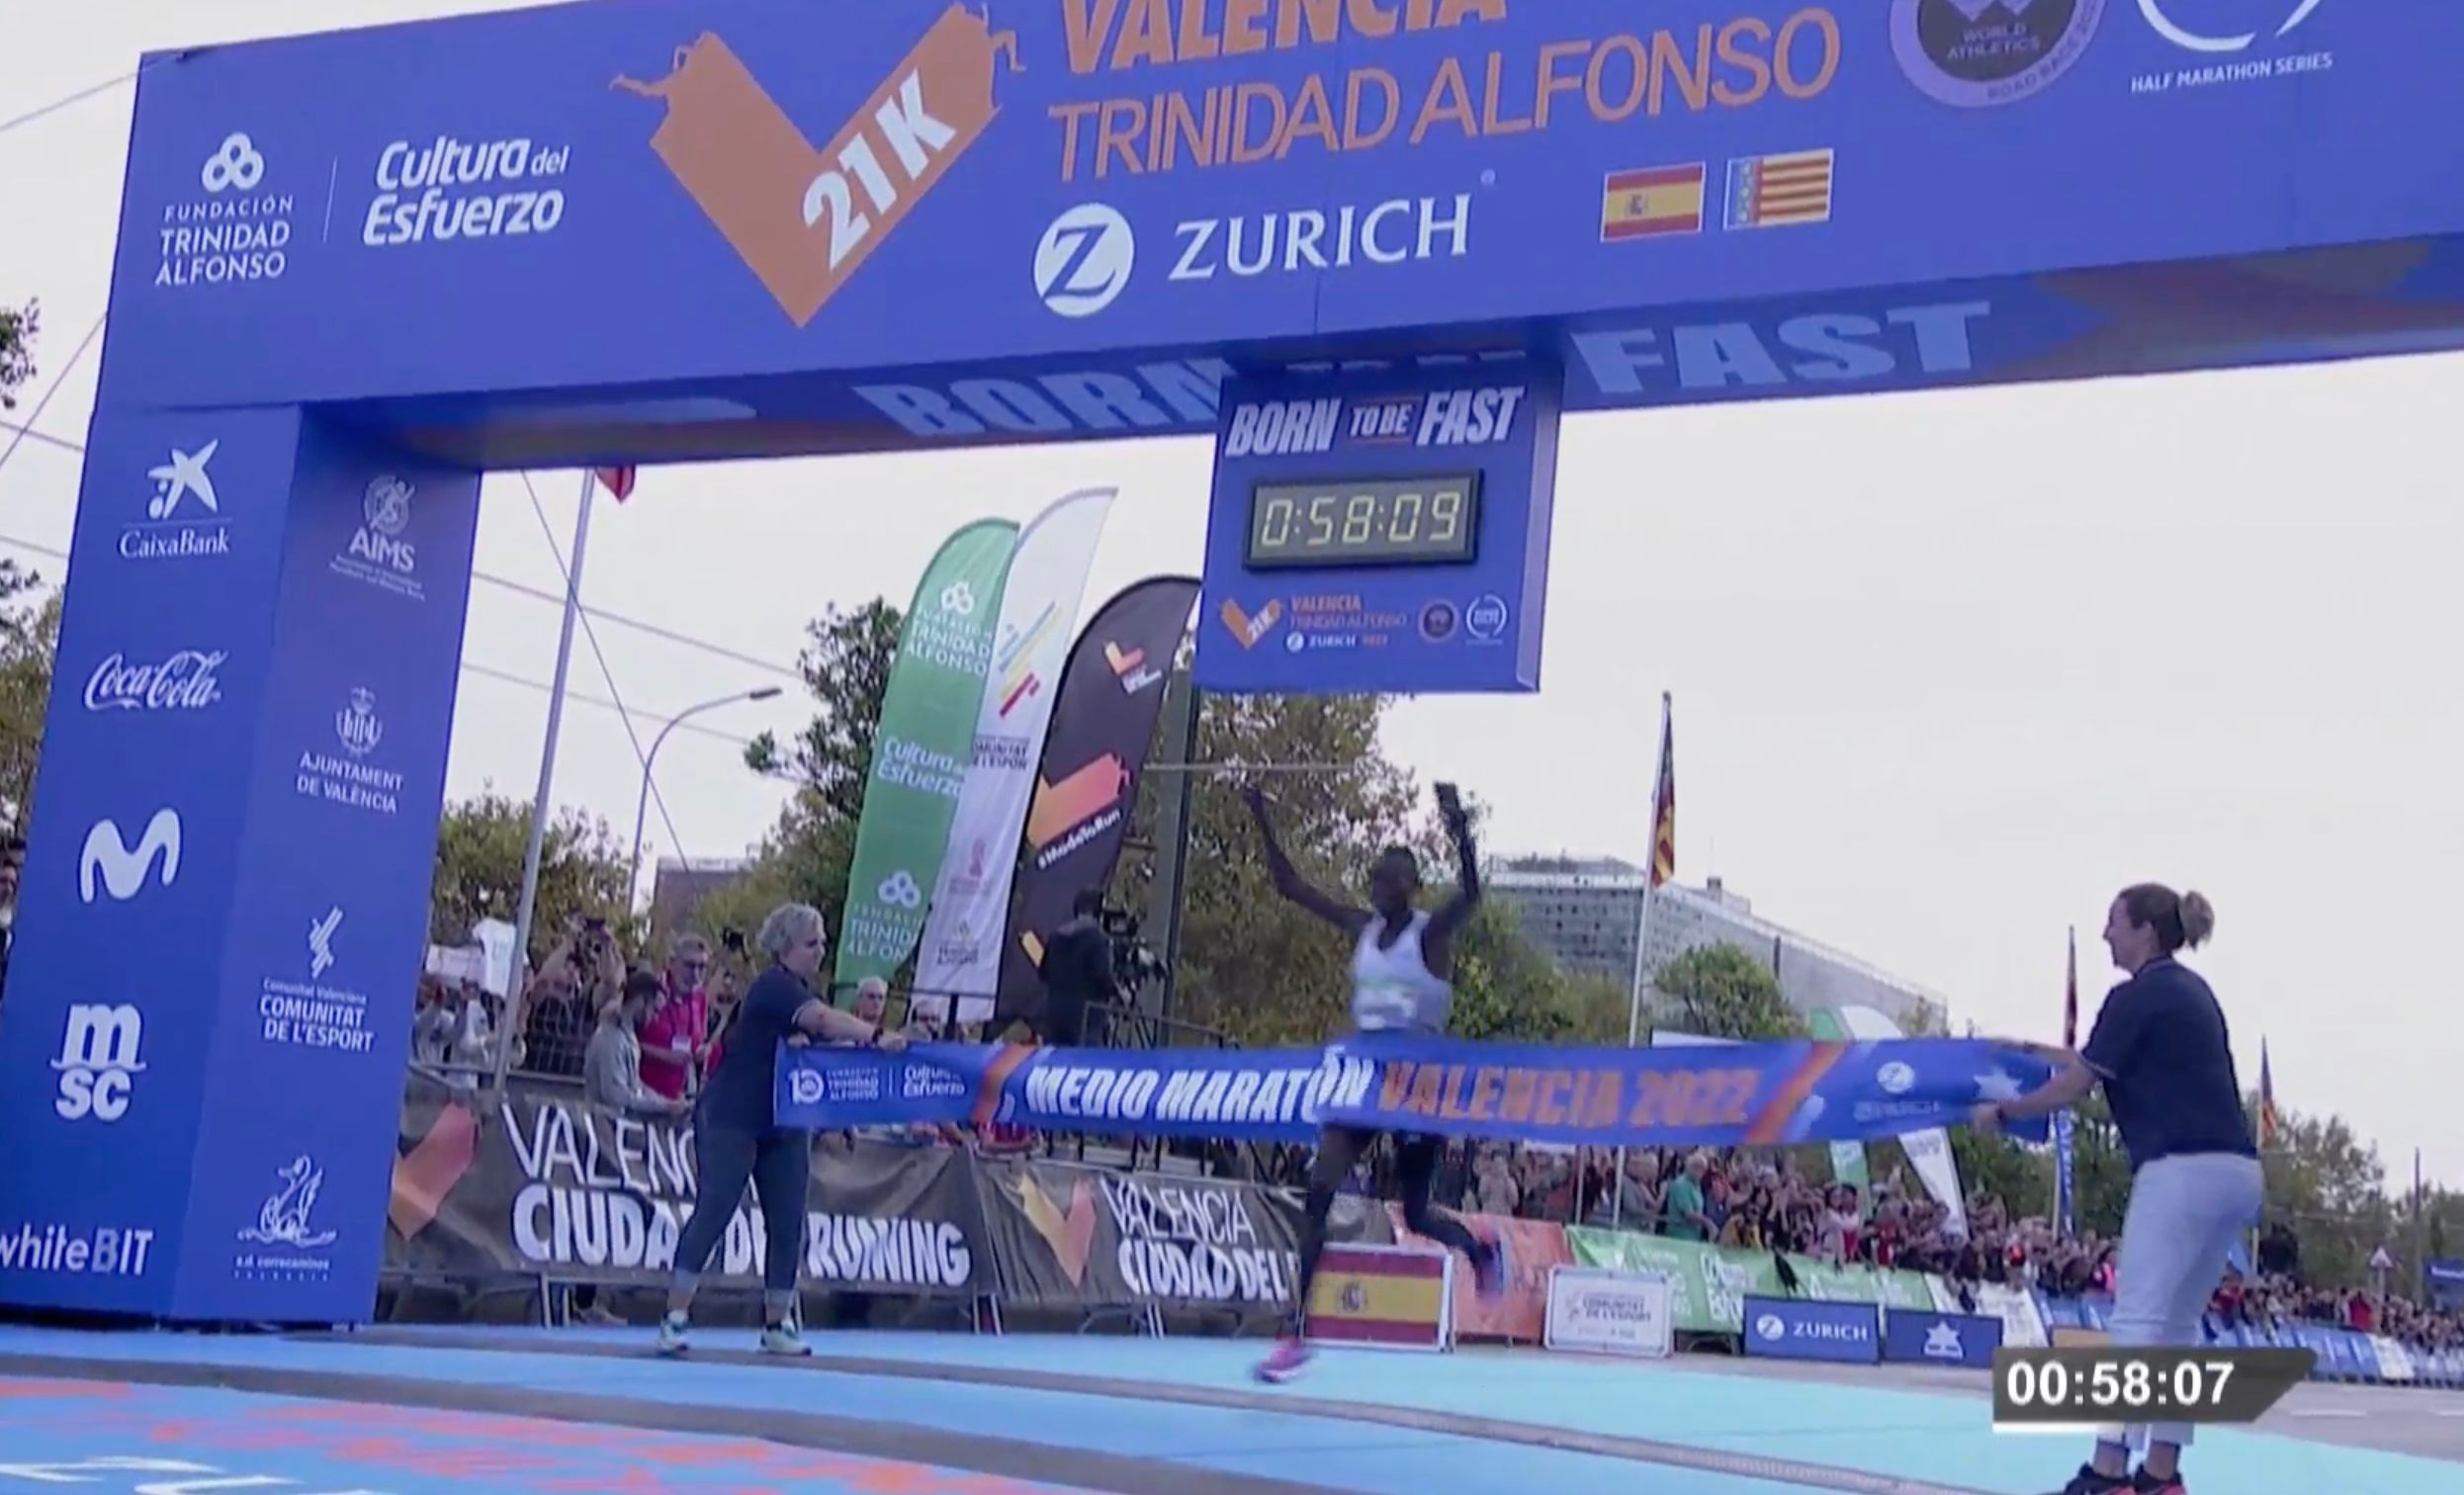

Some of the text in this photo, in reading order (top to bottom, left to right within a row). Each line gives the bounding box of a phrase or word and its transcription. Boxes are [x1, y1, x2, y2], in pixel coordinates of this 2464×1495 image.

[1062, 0, 1508, 75] VALEN
[1947, 36, 2041, 59] ATHLETICS
[1962, 23, 2026, 43] WORLD
[2131, 51, 2333, 94] HALF MARATHON SERIES
[1048, 8, 1841, 182] TRINIDAD ALFONSO
[375, 135, 571, 190] Cultura del
[803, 69, 957, 272] 21K
[164, 194, 294, 221] FUNDACIÓN
[362, 188, 565, 246] Esfuerzo
[159, 220, 291, 255] TRINIDAD
[1168, 192, 1472, 281] ZURICH
[154, 252, 287, 287] ALFONSO
[1571, 301, 1989, 393] FAST
[1225, 387, 1525, 457] BORN TO BE FAST
[1261, 491, 1460, 546] 0:58:09
[120, 526, 231, 559] CaixaBank
[349, 526, 416, 572] AIMS
[1289, 595, 1362, 612] VALENCIA
[904, 640, 987, 677] ALFONSO
[911, 617, 991, 659] TRINIDAD
[1309, 634, 1356, 649] ZURICH
[84, 650, 229, 712] Coca-Cola
[300, 749, 403, 791] AJUNTAMENT
[884, 736, 954, 771] Cultura
[298, 774, 319, 797] DE
[845, 940, 909, 967] ALFON
[260, 995, 365, 1028] COMUNITAT
[264, 1017, 375, 1052] DE L'ESPORT
[1025, 1044, 1762, 1128] MEDIO MARATÓN VALENCIA 2022
[1100, 1178, 1257, 1244] VALENCIA
[1117, 1239, 1236, 1300] CIUDAD
[1233, 1248, 1289, 1302] DEL
[1793, 1321, 1868, 1342] ZURICH
